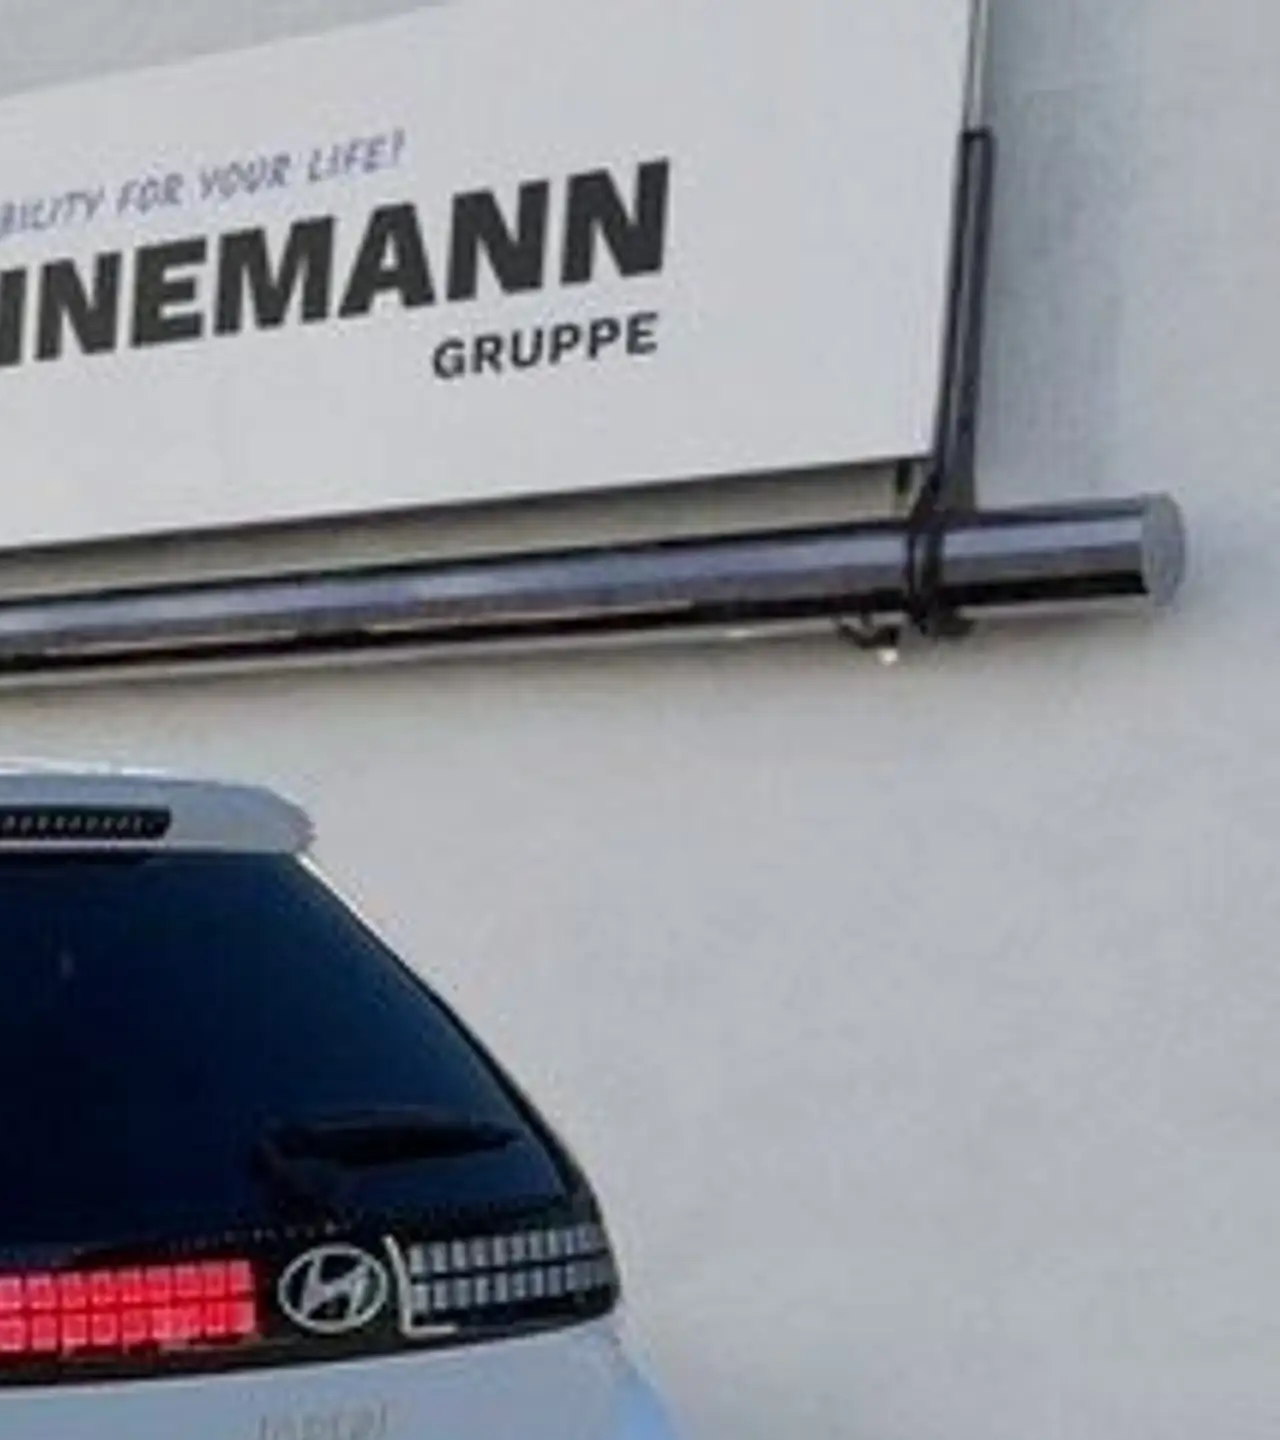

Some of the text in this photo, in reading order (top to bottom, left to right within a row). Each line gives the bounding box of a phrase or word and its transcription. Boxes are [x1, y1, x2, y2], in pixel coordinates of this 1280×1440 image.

[116, 171, 185, 217] FOR
[198, 151, 292, 202] YOUR
[306, 127, 407, 186] LIFE!
[432, 311, 659, 380] GRUPPE
